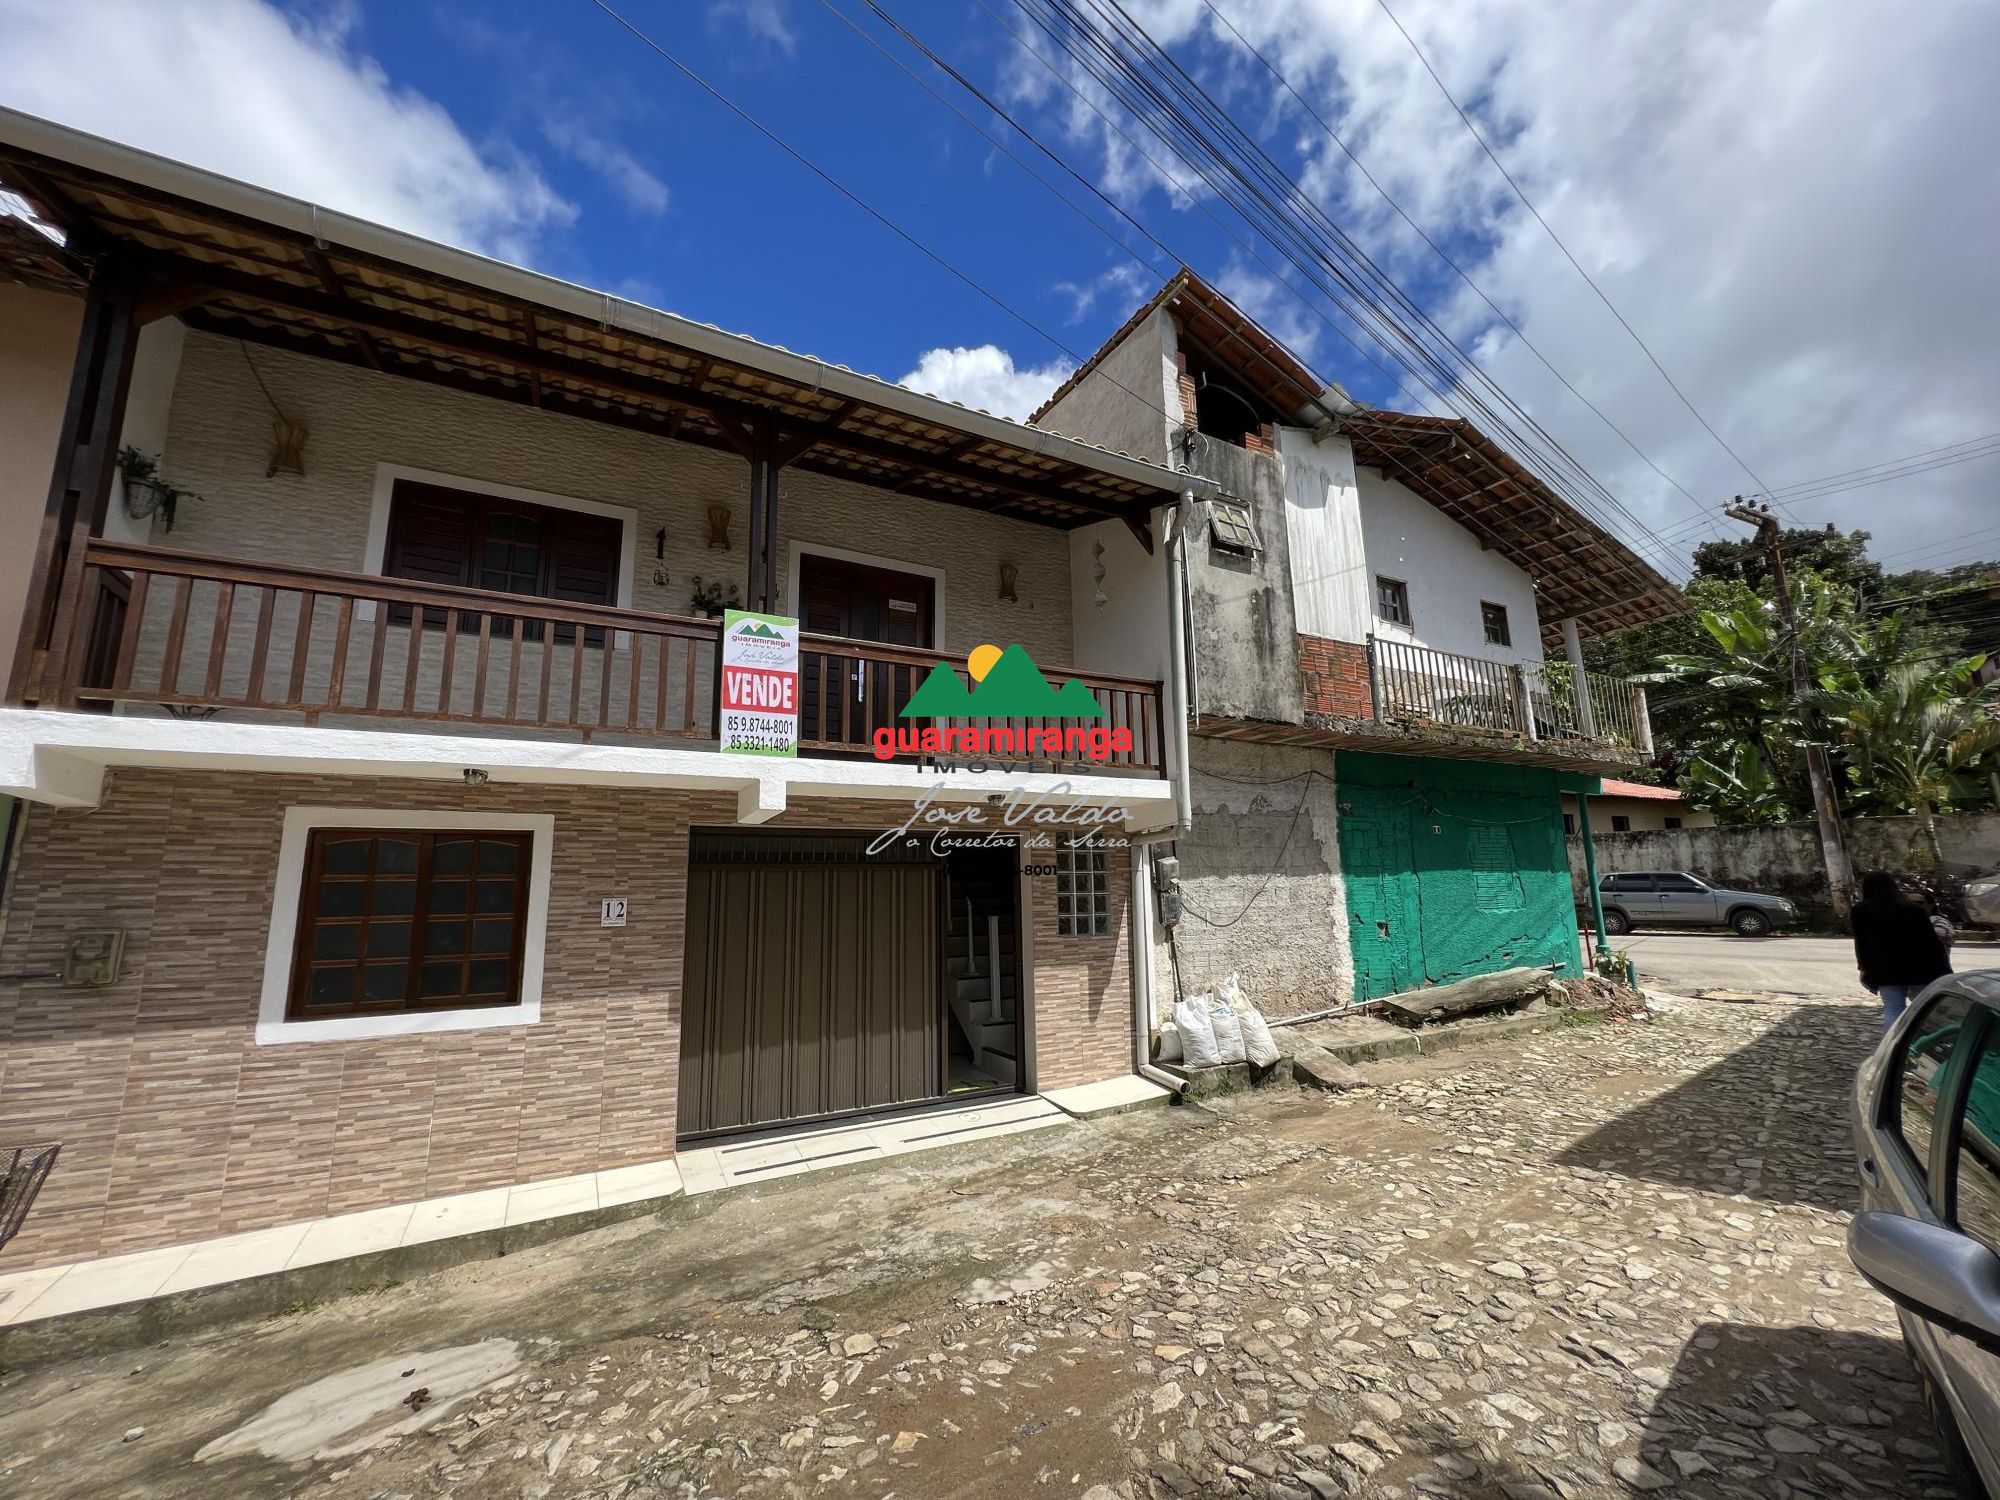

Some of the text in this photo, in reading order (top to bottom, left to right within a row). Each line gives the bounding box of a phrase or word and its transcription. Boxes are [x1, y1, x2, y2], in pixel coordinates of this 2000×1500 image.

[731, 634, 791, 648] guaramiranga
[727, 671, 793, 709] VENDE
[728, 716, 793, 735] 85 9.8744-8001
[730, 734, 790, 752] 85 3321-1480
[605, 901, 625, 918] 12
